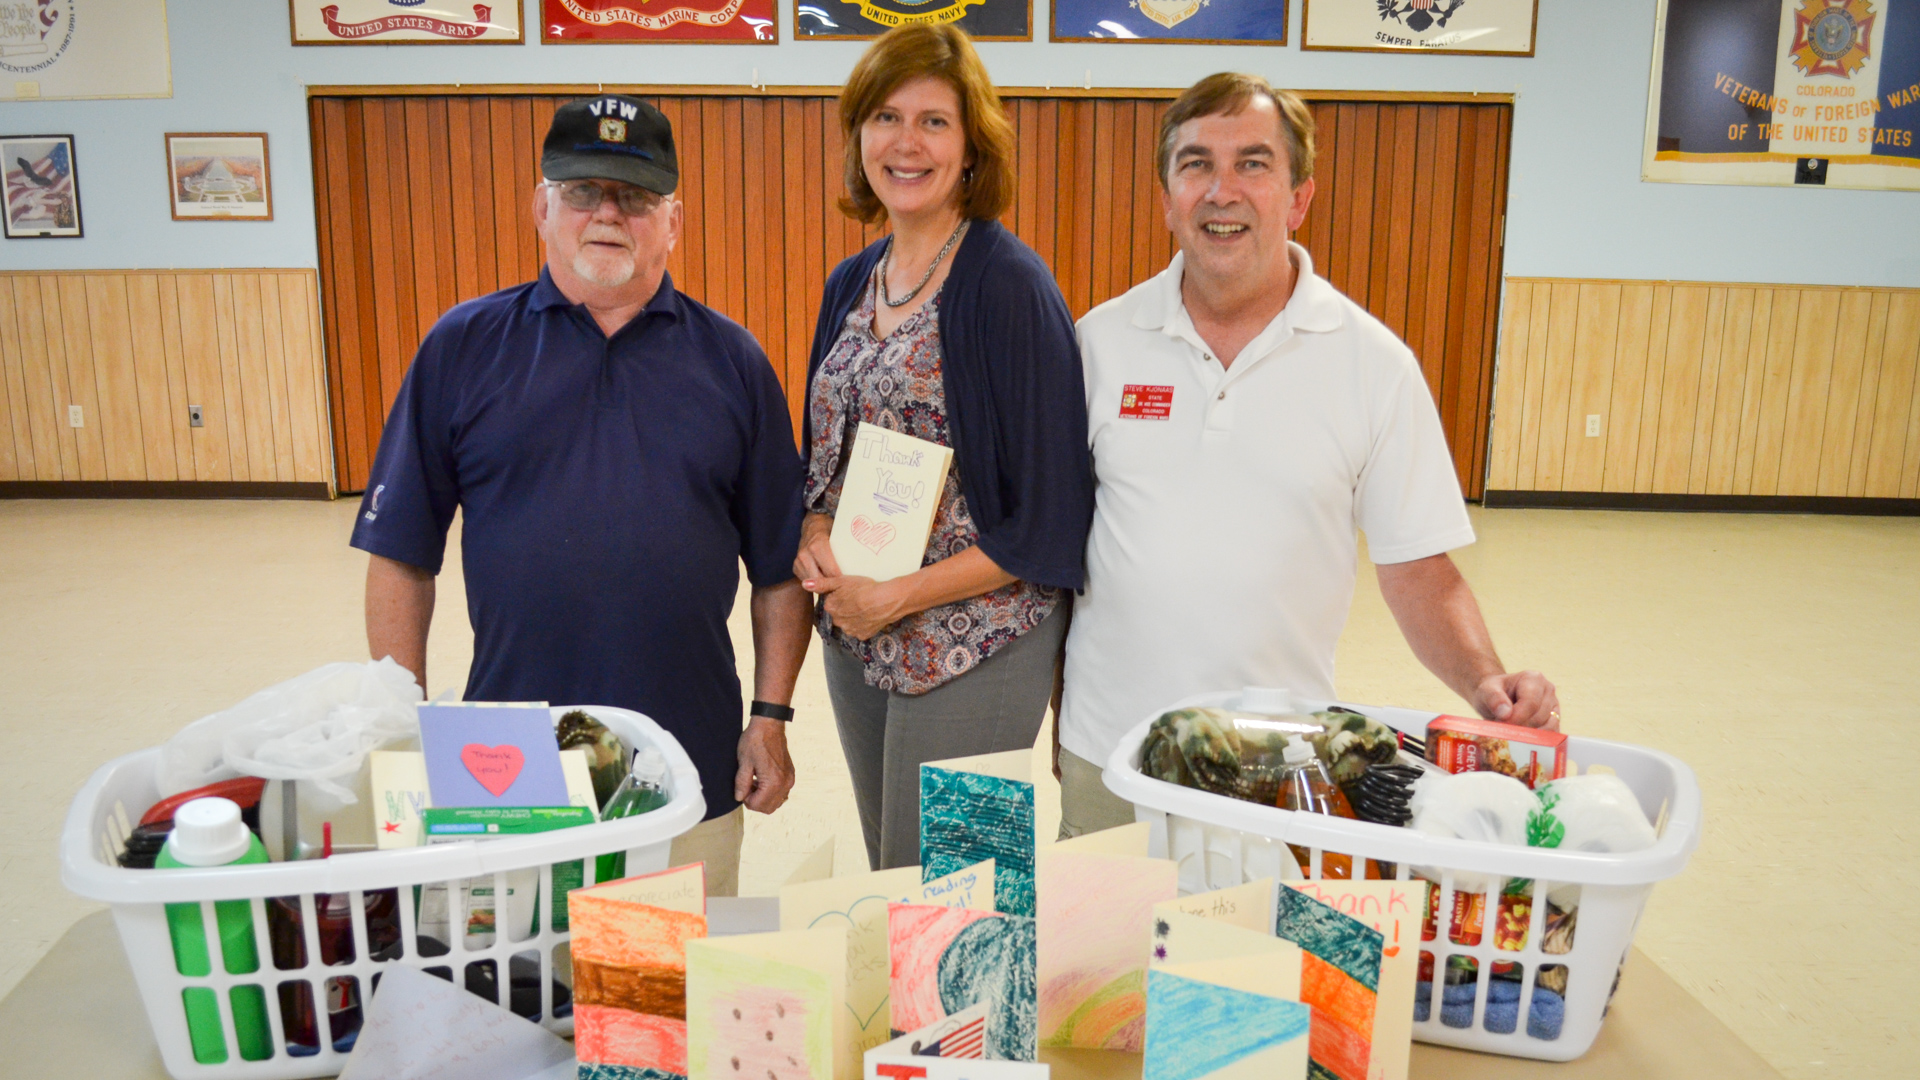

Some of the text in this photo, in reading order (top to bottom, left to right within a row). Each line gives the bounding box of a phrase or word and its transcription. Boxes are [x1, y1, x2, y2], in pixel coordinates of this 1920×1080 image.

[564, 0, 739, 28] NITED STATES MARINE CORP
[867, 7, 899, 25] UNITED
[938, 6, 961, 21] NAVY
[59, 13, 75, 53] 1987-1991
[338, 17, 479, 36] UNITED STATES ARMY
[1375, 31, 1412, 46] SEMPER
[0, 57, 57, 73] CENTENNIAL
[1714, 72, 1788, 114] VETERANS
[1815, 98, 1880, 121] FOREIGN
[1887, 83, 1920, 109] WAR
[1796, 85, 1855, 97] COLORADO
[589, 98, 637, 121] VFW
[1728, 124, 1912, 147] OF THE UNITED STATES
[858, 430, 924, 467] Thank
[876, 467, 925, 508] You!
[471, 751, 511, 760] Thank
[1466, 744, 1477, 772] CHEW
[923, 873, 977, 899] reading
[1211, 896, 1236, 917] this
